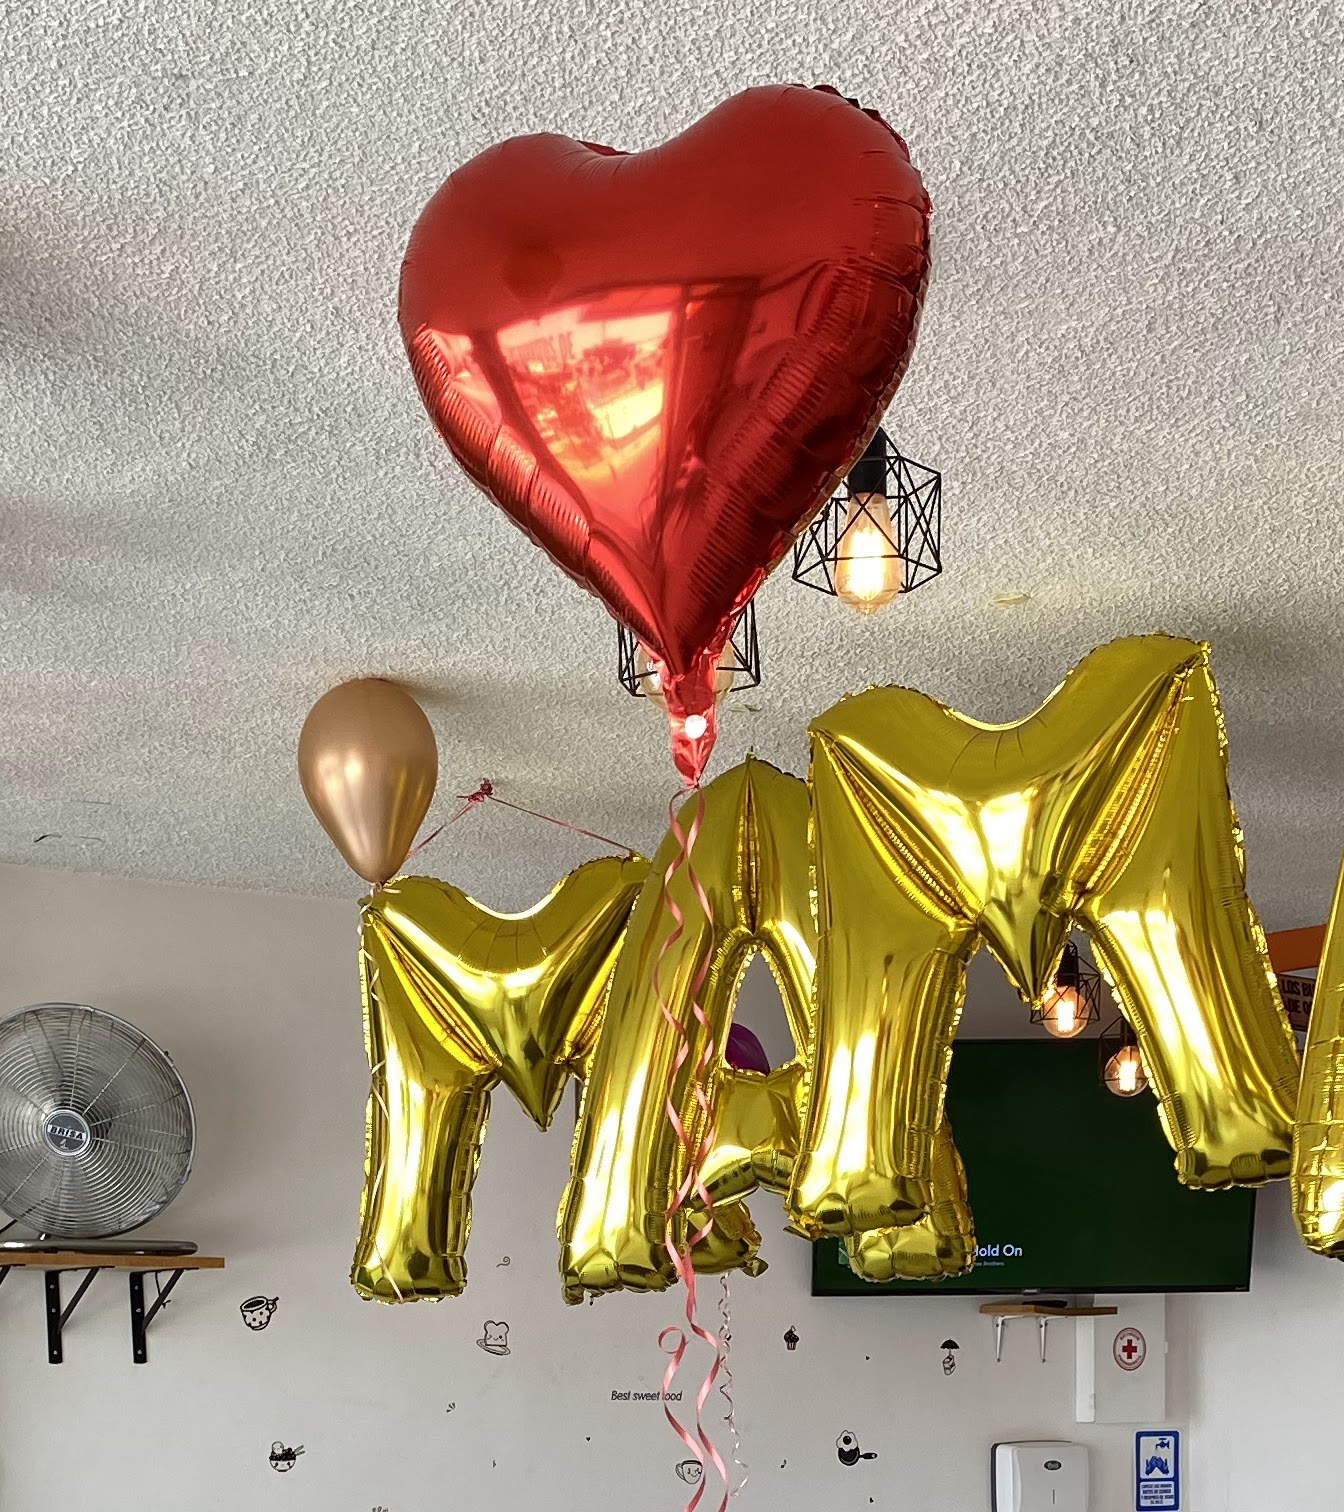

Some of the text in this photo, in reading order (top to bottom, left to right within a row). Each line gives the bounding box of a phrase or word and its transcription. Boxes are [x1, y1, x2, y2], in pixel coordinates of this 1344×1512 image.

[49, 1125, 85, 1140] BRISA
[1003, 1244, 1023, 1257] On
[611, 1390, 631, 1401] Best
[633, 1391, 660, 1401] sweet
